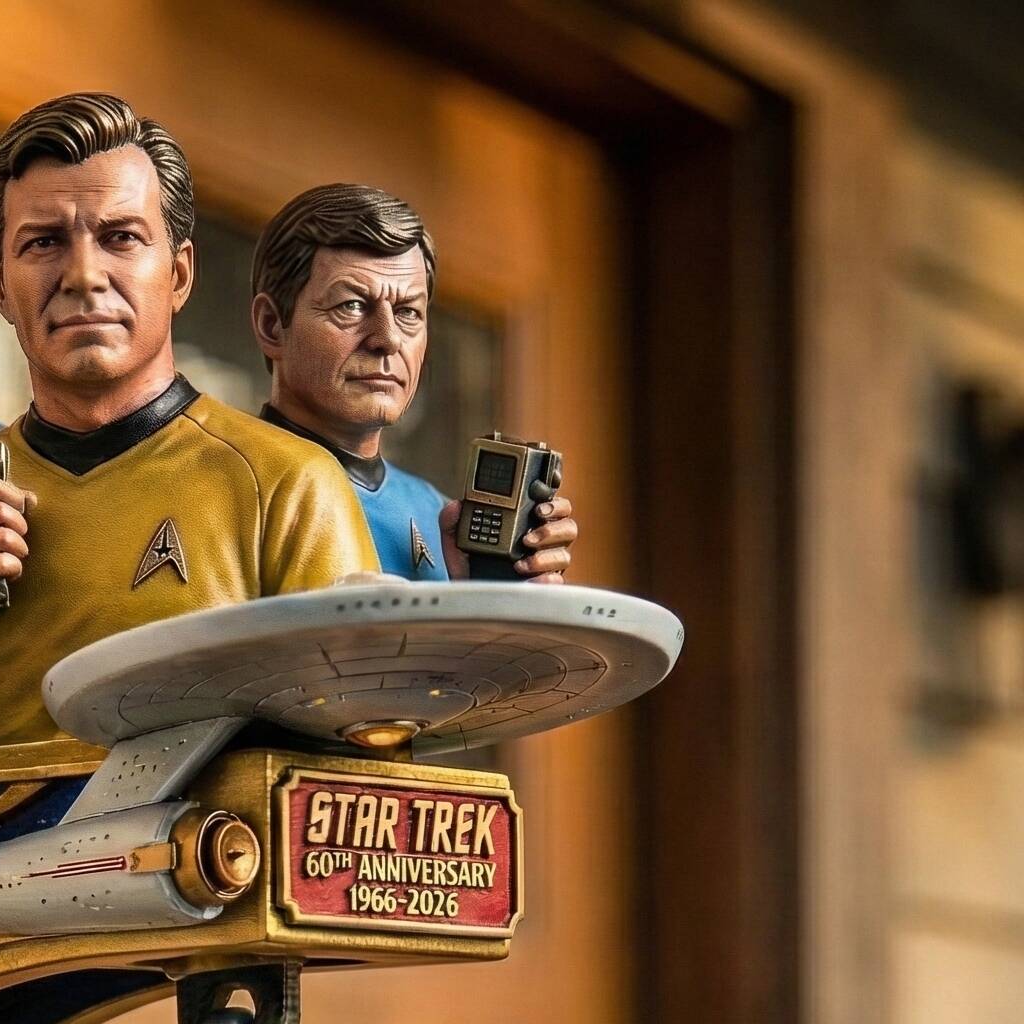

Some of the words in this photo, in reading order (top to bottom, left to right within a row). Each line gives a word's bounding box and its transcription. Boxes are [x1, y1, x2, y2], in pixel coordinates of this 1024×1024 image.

[307, 791, 400, 849] STAR
[413, 800, 498, 855] TREK
[306, 851, 352, 877] 60TH
[358, 854, 497, 888] ANNIVERSARY
[349, 884, 459, 917] 1966-2026
